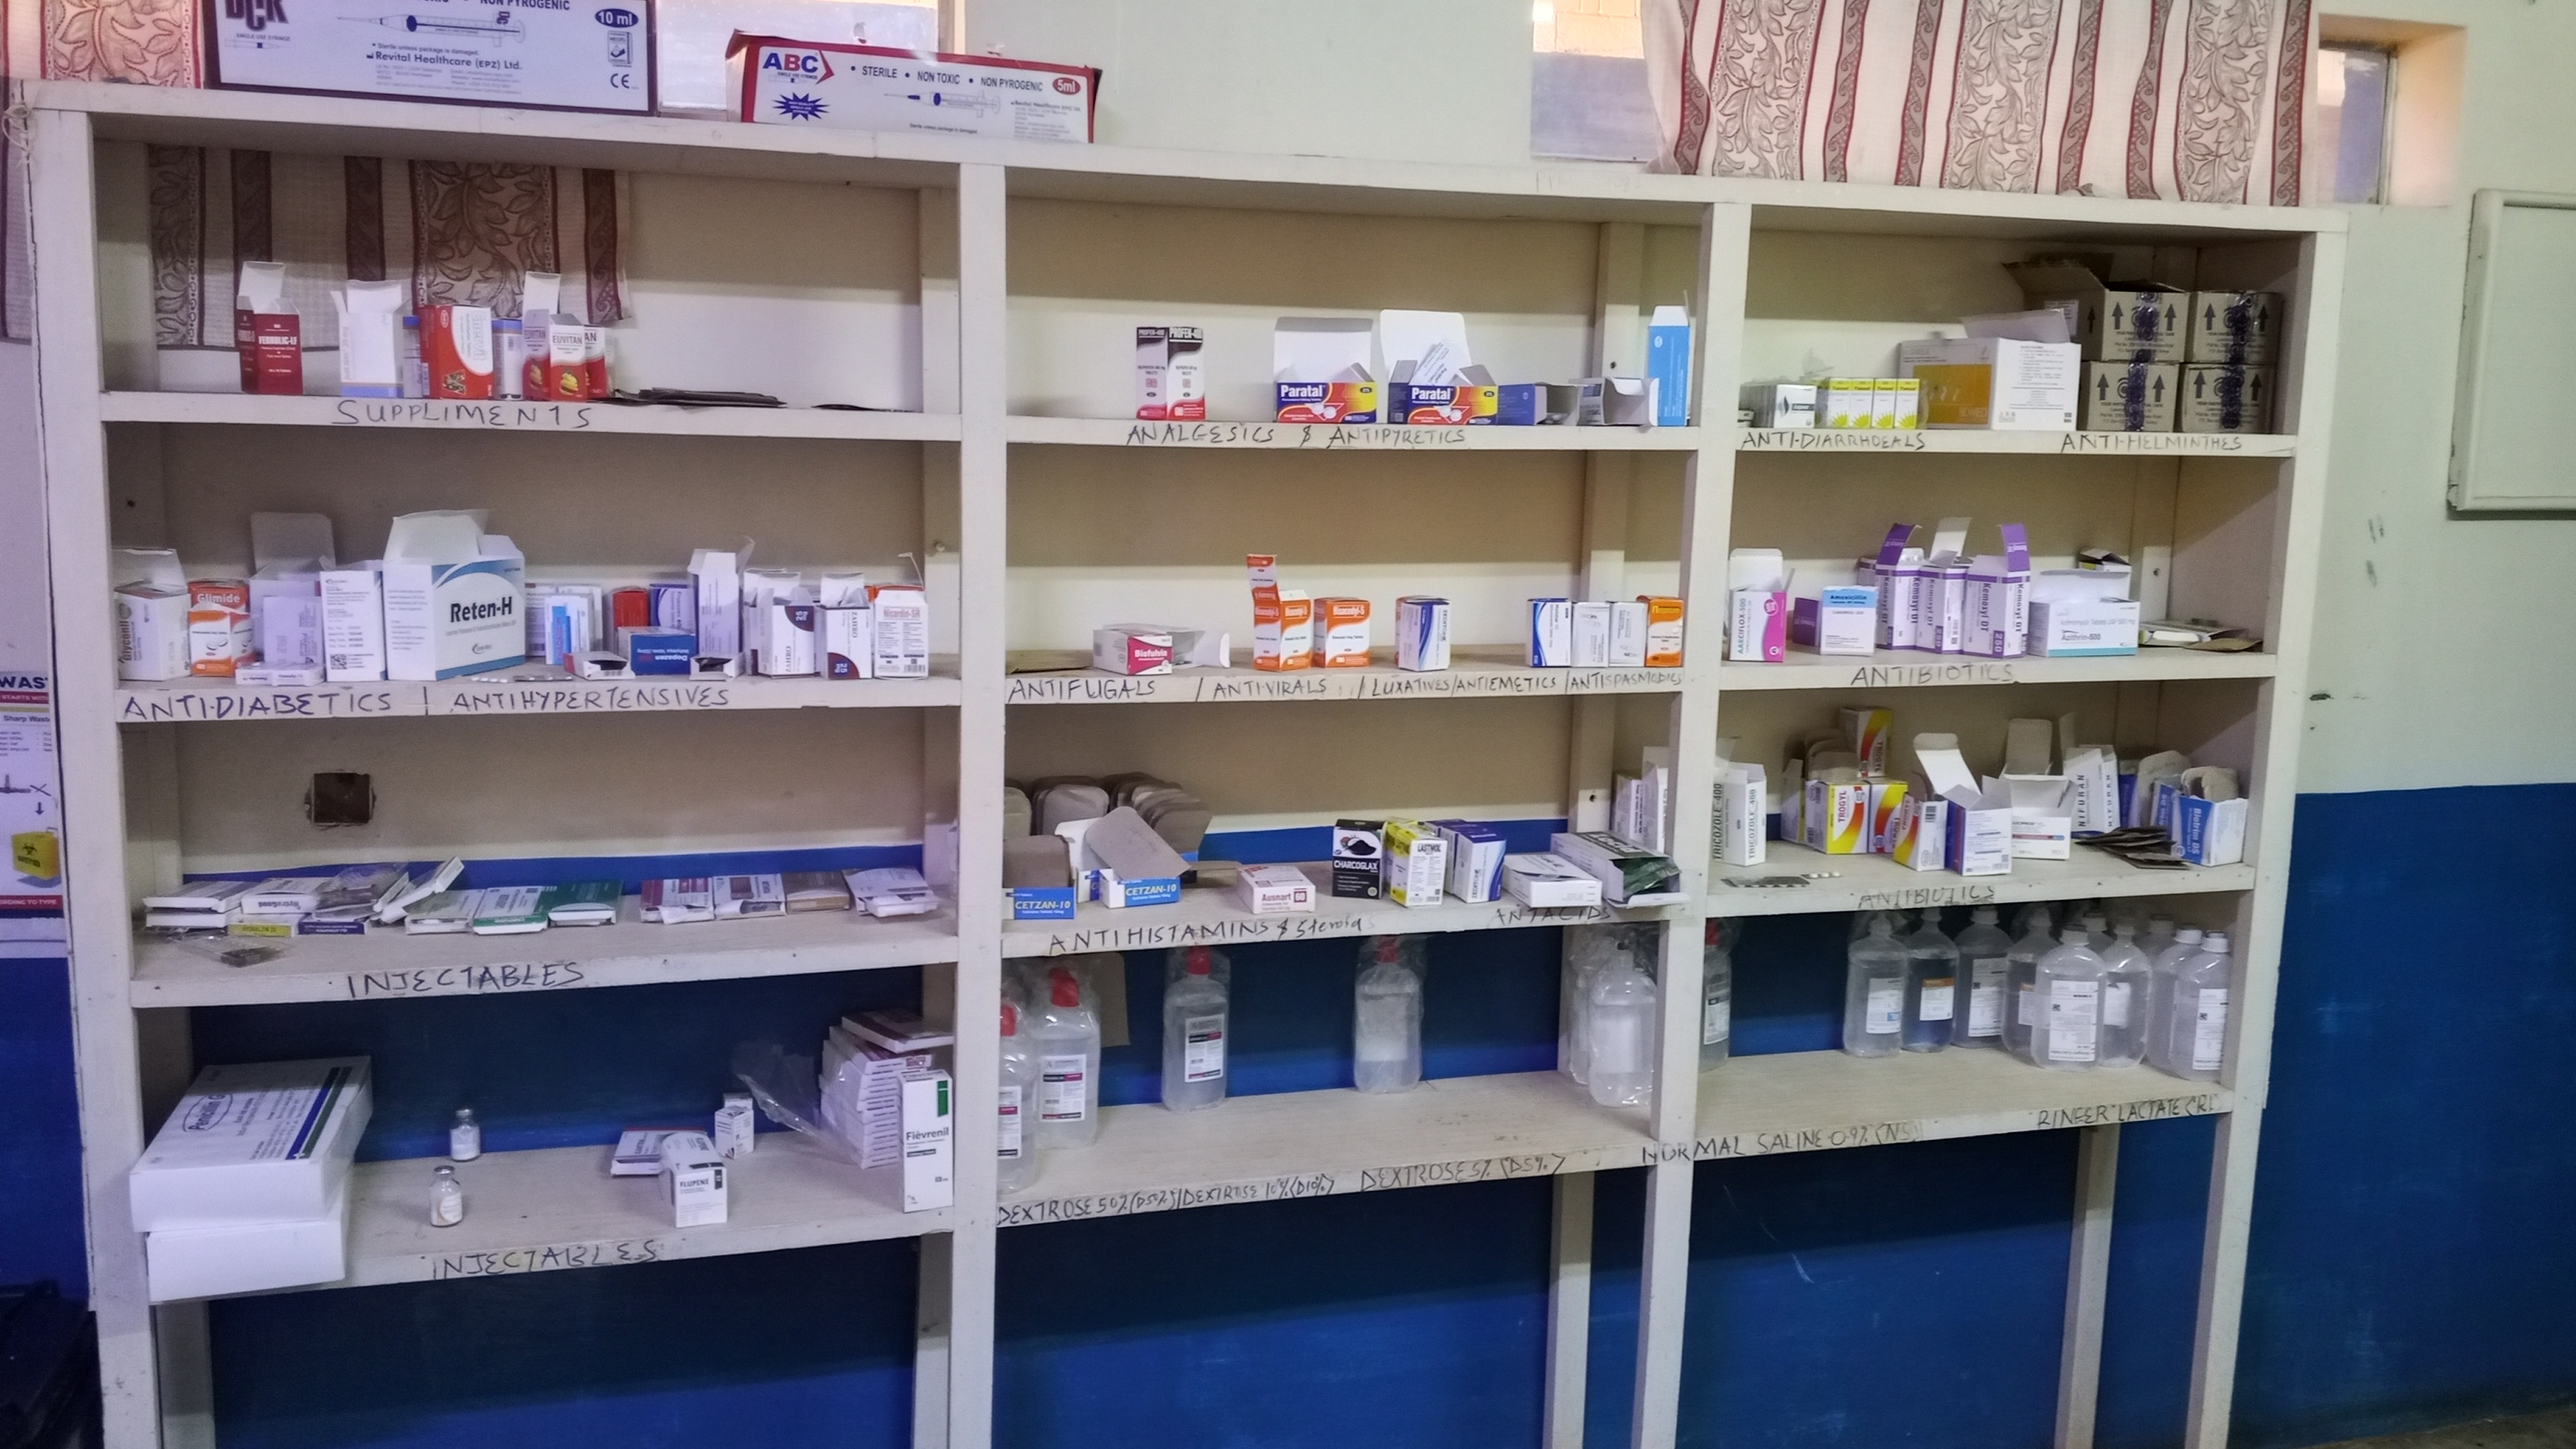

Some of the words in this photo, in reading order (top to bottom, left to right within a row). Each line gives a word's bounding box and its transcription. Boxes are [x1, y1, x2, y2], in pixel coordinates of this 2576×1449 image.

[598, 11, 613, 24] 10
[616, 12, 633, 25] ml
[376, 52, 411, 62] Revital
[415, 54, 472, 66] Healthcare
[475, 59, 500, 70] (EPZ)
[762, 52, 818, 73] ABC
[862, 66, 898, 78] STERILE
[917, 71, 935, 83] NON
[937, 72, 961, 85] TOXIC
[981, 77, 998, 87] NON
[999, 78, 1043, 92] PYROGENIC
[1057, 79, 1076, 93] 5ml
[524, 329, 546, 339] EUVITAN
[552, 335, 583, 345] EUVITAN
[1281, 384, 1324, 399] Paratal
[1411, 388, 1451, 402] Paratal
[330, 399, 592, 429] SUPPLIMENTS
[1126, 424, 1275, 446] ANALGESICS
[1326, 426, 1466, 449] ANTIPYRETICS
[197, 594, 240, 604] Glimide
[1912, 577, 1921, 608] Kemoxyl
[1927, 578, 1935, 609] Kemoxyl
[1981, 582, 1992, 614] Kemoxyl
[2016, 582, 2024, 614] Kemoxyl
[449, 596, 513, 623] Reten-H
[1912, 609, 1920, 624] DT
[1927, 611, 1934, 627] DT
[1980, 616, 1989, 633] DT
[2015, 616, 2023, 633] DT
[1994, 633, 2002, 653] 250
[654, 654, 688, 662] Dopazen
[1134, 648, 1168, 658] Biofulvin
[1850, 663, 2015, 686] ANTIBIOTICS
[452, 686, 730, 712] ANTIHYPERTENSIVES
[1008, 678, 1157, 703] ANTIFUGALS
[3, 715, 27, 723] Sharp
[1837, 790, 1847, 823] TROGYL
[2192, 841, 2200, 855] DS
[1334, 859, 1378, 871] CHARCOGLAX
[1126, 883, 1177, 897] CETZAN-10
[1015, 900, 1071, 910] CETZAN-10
[1491, 904, 1612, 927] ANTACIDS
[1049, 920, 1269, 955] ANTIHISTAMINS
[347, 961, 584, 998] INJECTABLES
[187, 1100, 222, 1132] Penicillin
[906, 1127, 949, 1140] Fièvrenil
[1642, 1136, 1746, 1165] NORMAL
[1758, 1130, 1823, 1154] SALINE
[433, 1240, 657, 1280] INJECTABLES
